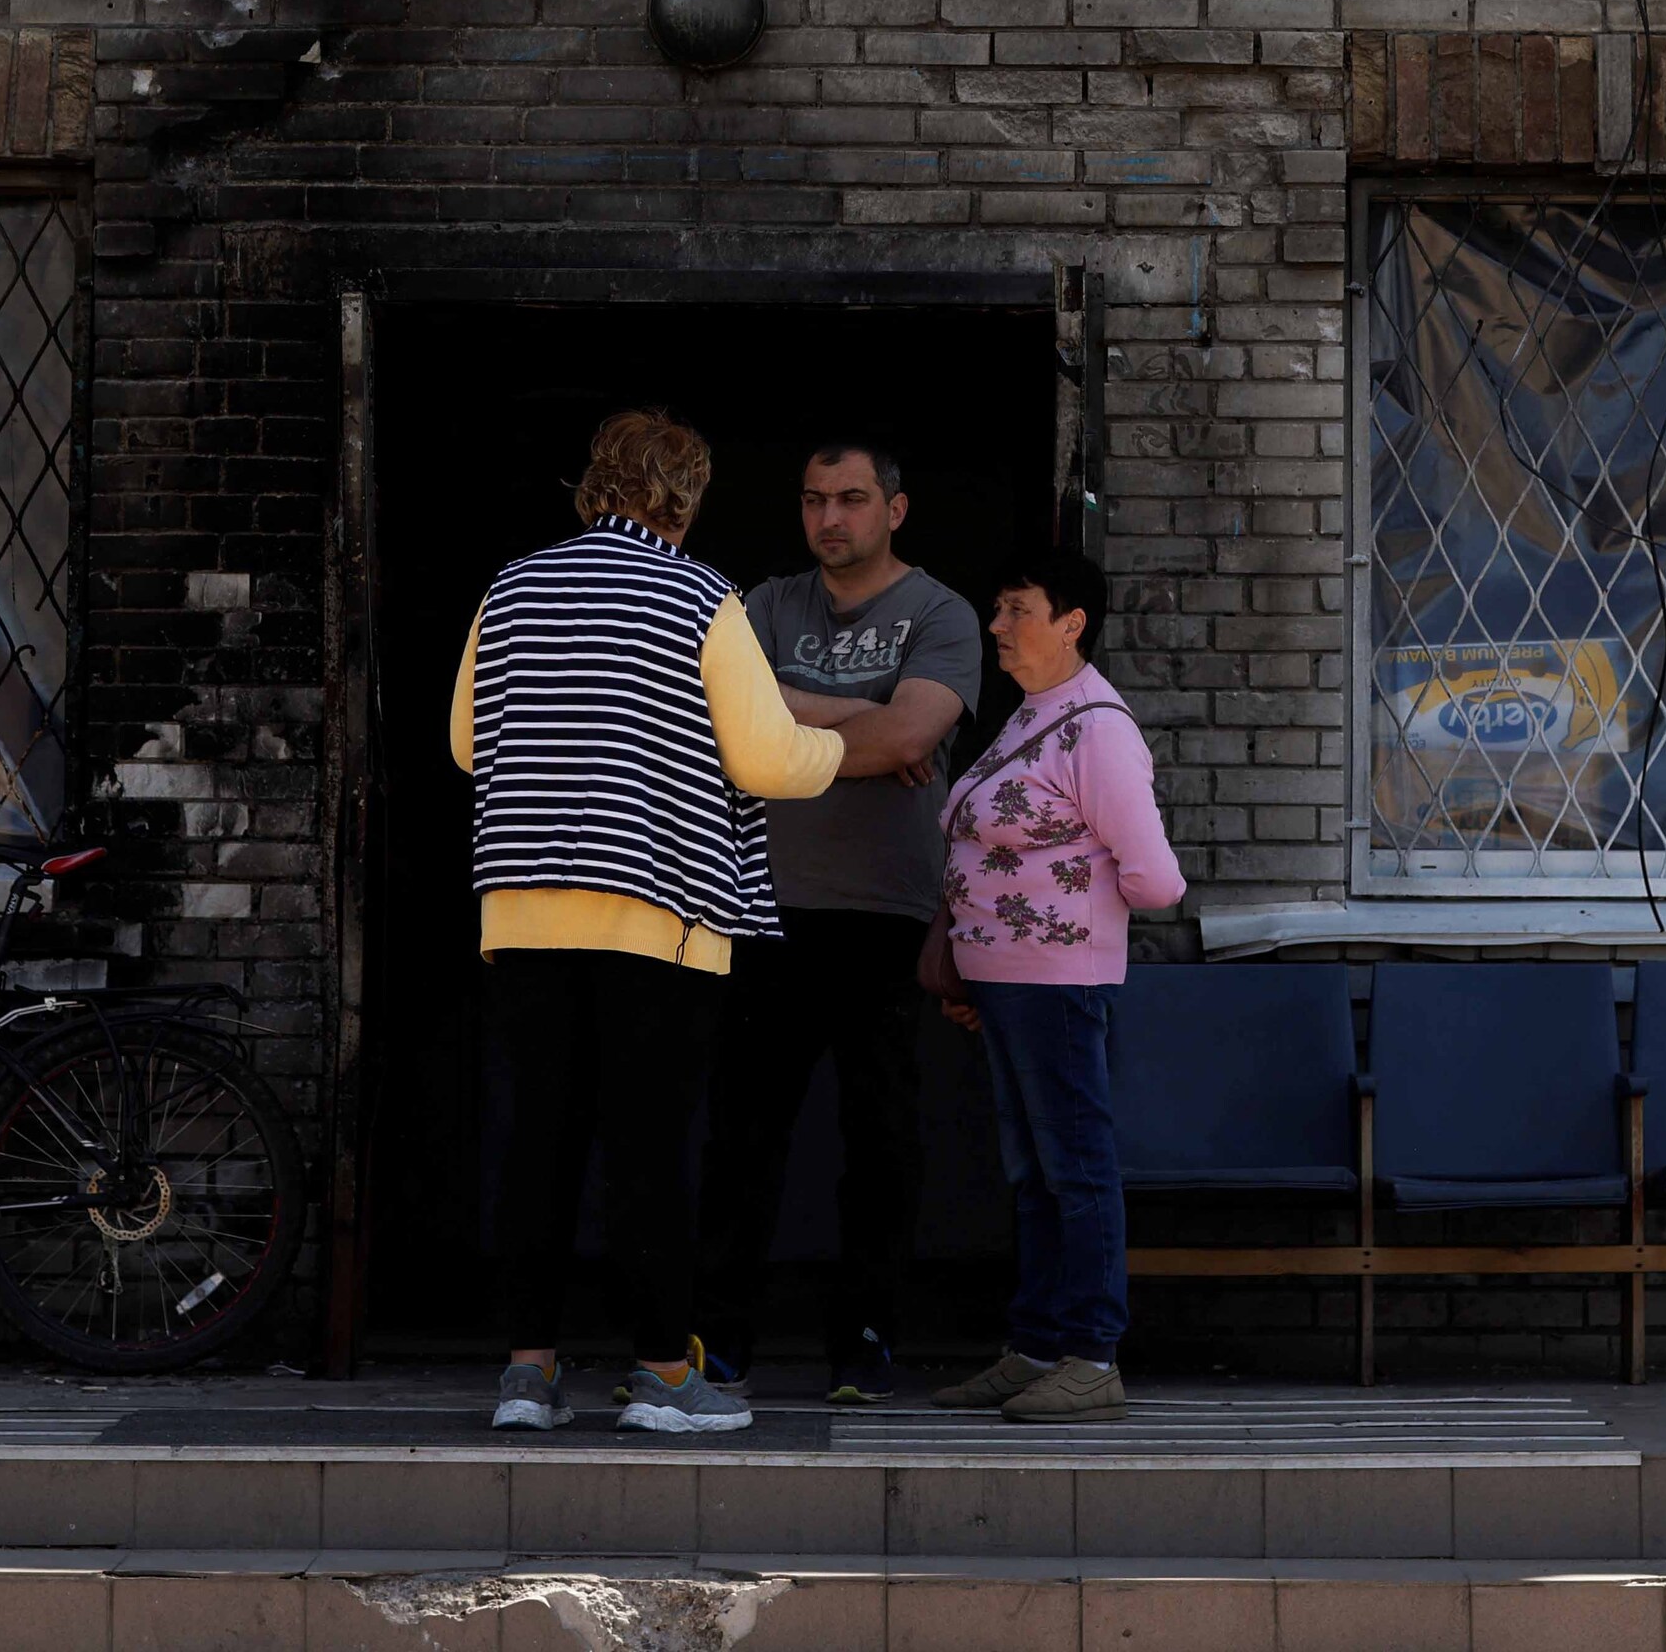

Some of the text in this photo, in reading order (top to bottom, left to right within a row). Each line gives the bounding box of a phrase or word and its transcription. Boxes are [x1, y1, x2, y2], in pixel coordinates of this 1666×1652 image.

[830, 618, 913, 655] 24.7
[1471, 676, 1521, 688] QUAITY
[1448, 698, 1547, 741] derby
